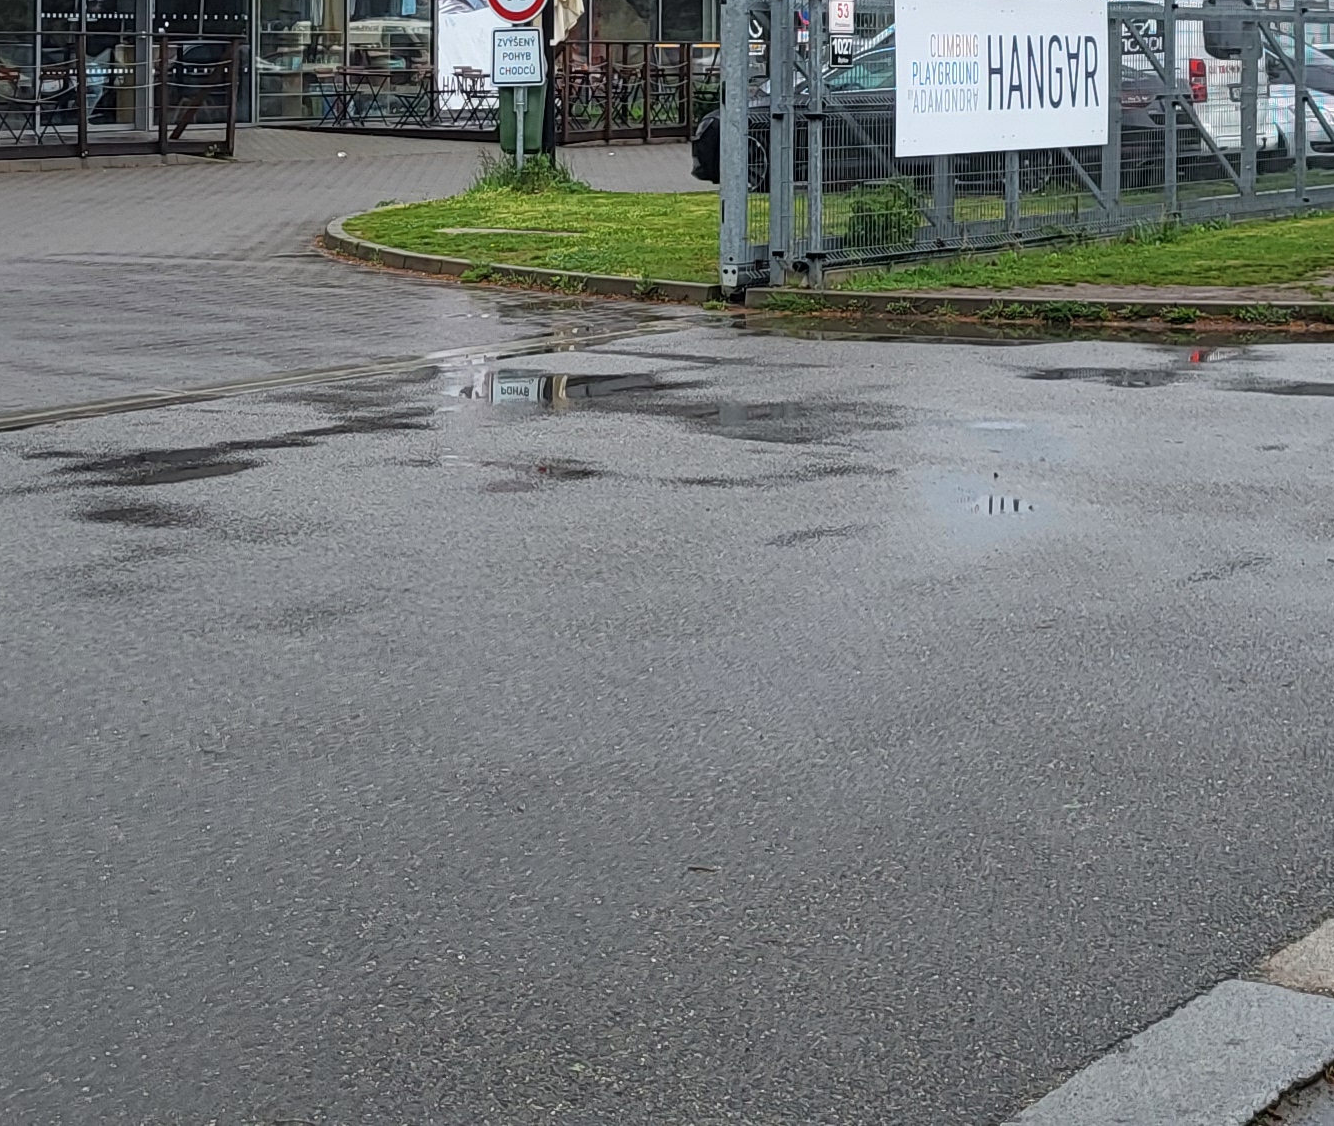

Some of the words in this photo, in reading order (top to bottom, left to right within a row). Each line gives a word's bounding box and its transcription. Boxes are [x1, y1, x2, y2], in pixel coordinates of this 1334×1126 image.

[837, 3, 850, 19] 53
[497, 36, 536, 48] ZVÝŠENÝ
[832, 38, 853, 55] 1027
[930, 33, 979, 58] CLIMBING
[502, 52, 532, 62] POHYB
[499, 64, 536, 76] CHODCŮ
[912, 60, 979, 86] PLAYGROUND
